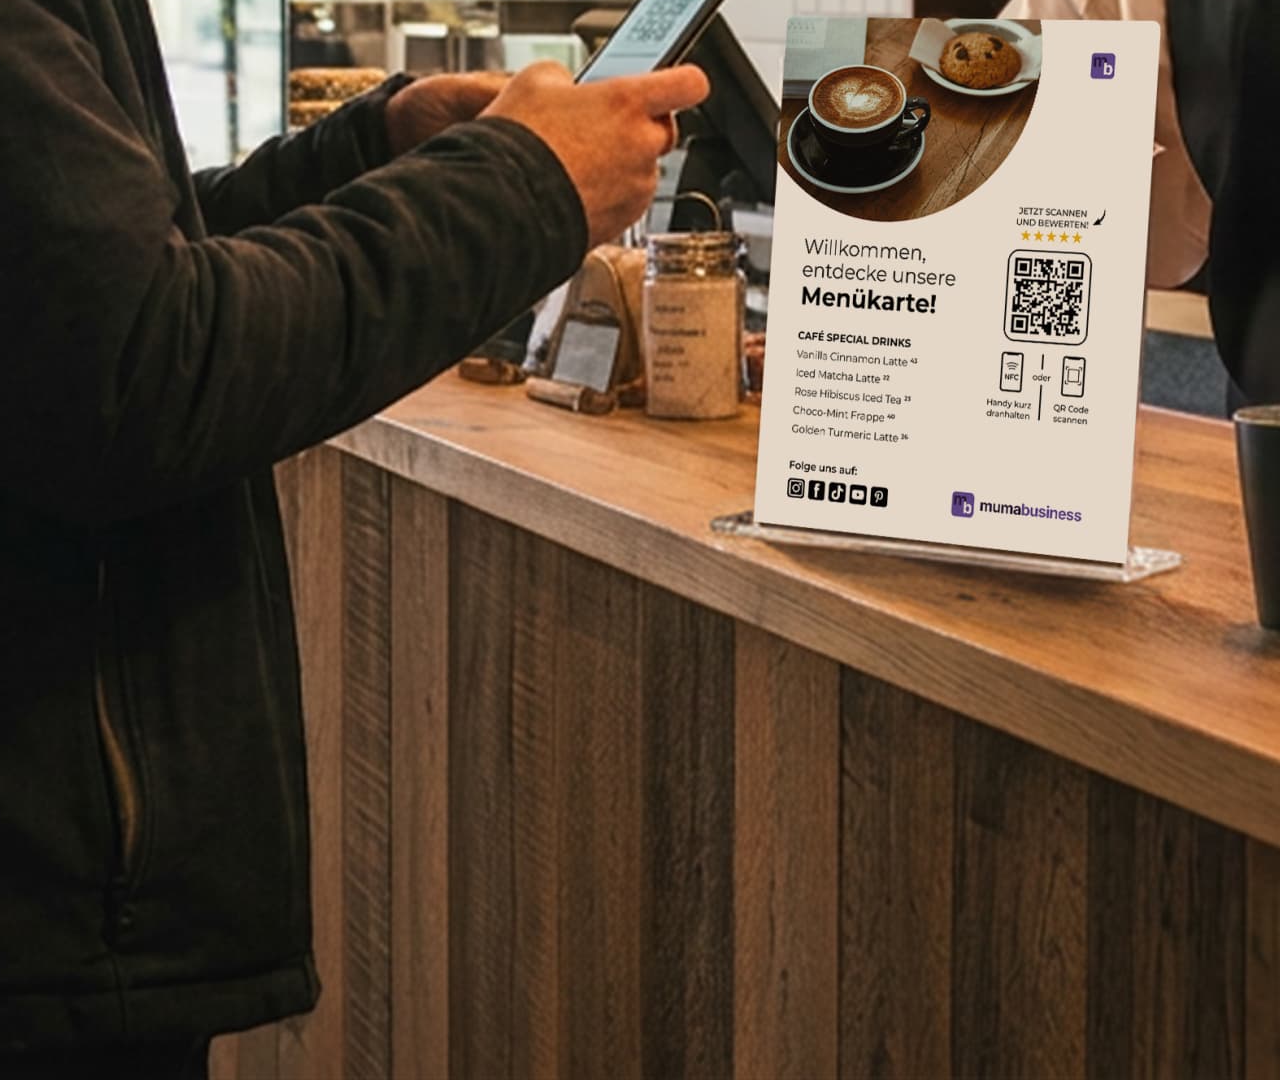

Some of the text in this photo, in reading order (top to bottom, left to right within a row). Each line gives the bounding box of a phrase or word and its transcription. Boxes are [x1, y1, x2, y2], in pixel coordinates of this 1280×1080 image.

[1018, 206, 1088, 218] JETZT SCANNEN
[1016, 217, 1089, 229] UND BEWERTEN!
[804, 238, 927, 264] Willkommen,
[802, 263, 956, 287] entdecke unsere
[801, 286, 937, 314] Menükarte!
[798, 330, 912, 348] CAFÉ SPECIAL DRINKS
[796, 349, 828, 361] Vanilla
[829, 352, 881, 365] Cinnamon
[882, 356, 908, 367] Latte
[796, 368, 816, 379] Iced
[818, 370, 854, 382] Matcha
[855, 373, 881, 384] Latte
[1004, 373, 1019, 381] NFC
[1032, 374, 1052, 382] oder
[794, 386, 818, 398] Rose
[819, 388, 860, 401] Hibiscus
[862, 392, 883, 403] Iced
[885, 394, 902, 405] Tea
[986, 398, 1032, 410] Handy kurz
[1053, 403, 1089, 415] QR Code
[792, 405, 849, 420] Choco-Mint
[850, 410, 885, 424] Frappe
[986, 409, 1031, 421] dranhalten
[1052, 416, 1088, 425] scannen
[791, 424, 826, 436] Golden
[828, 427, 871, 441] Turmeric
[873, 431, 899, 443] Latte
[789, 460, 858, 476] Folge uns auf:
[979, 501, 1083, 522] mumabusiness
